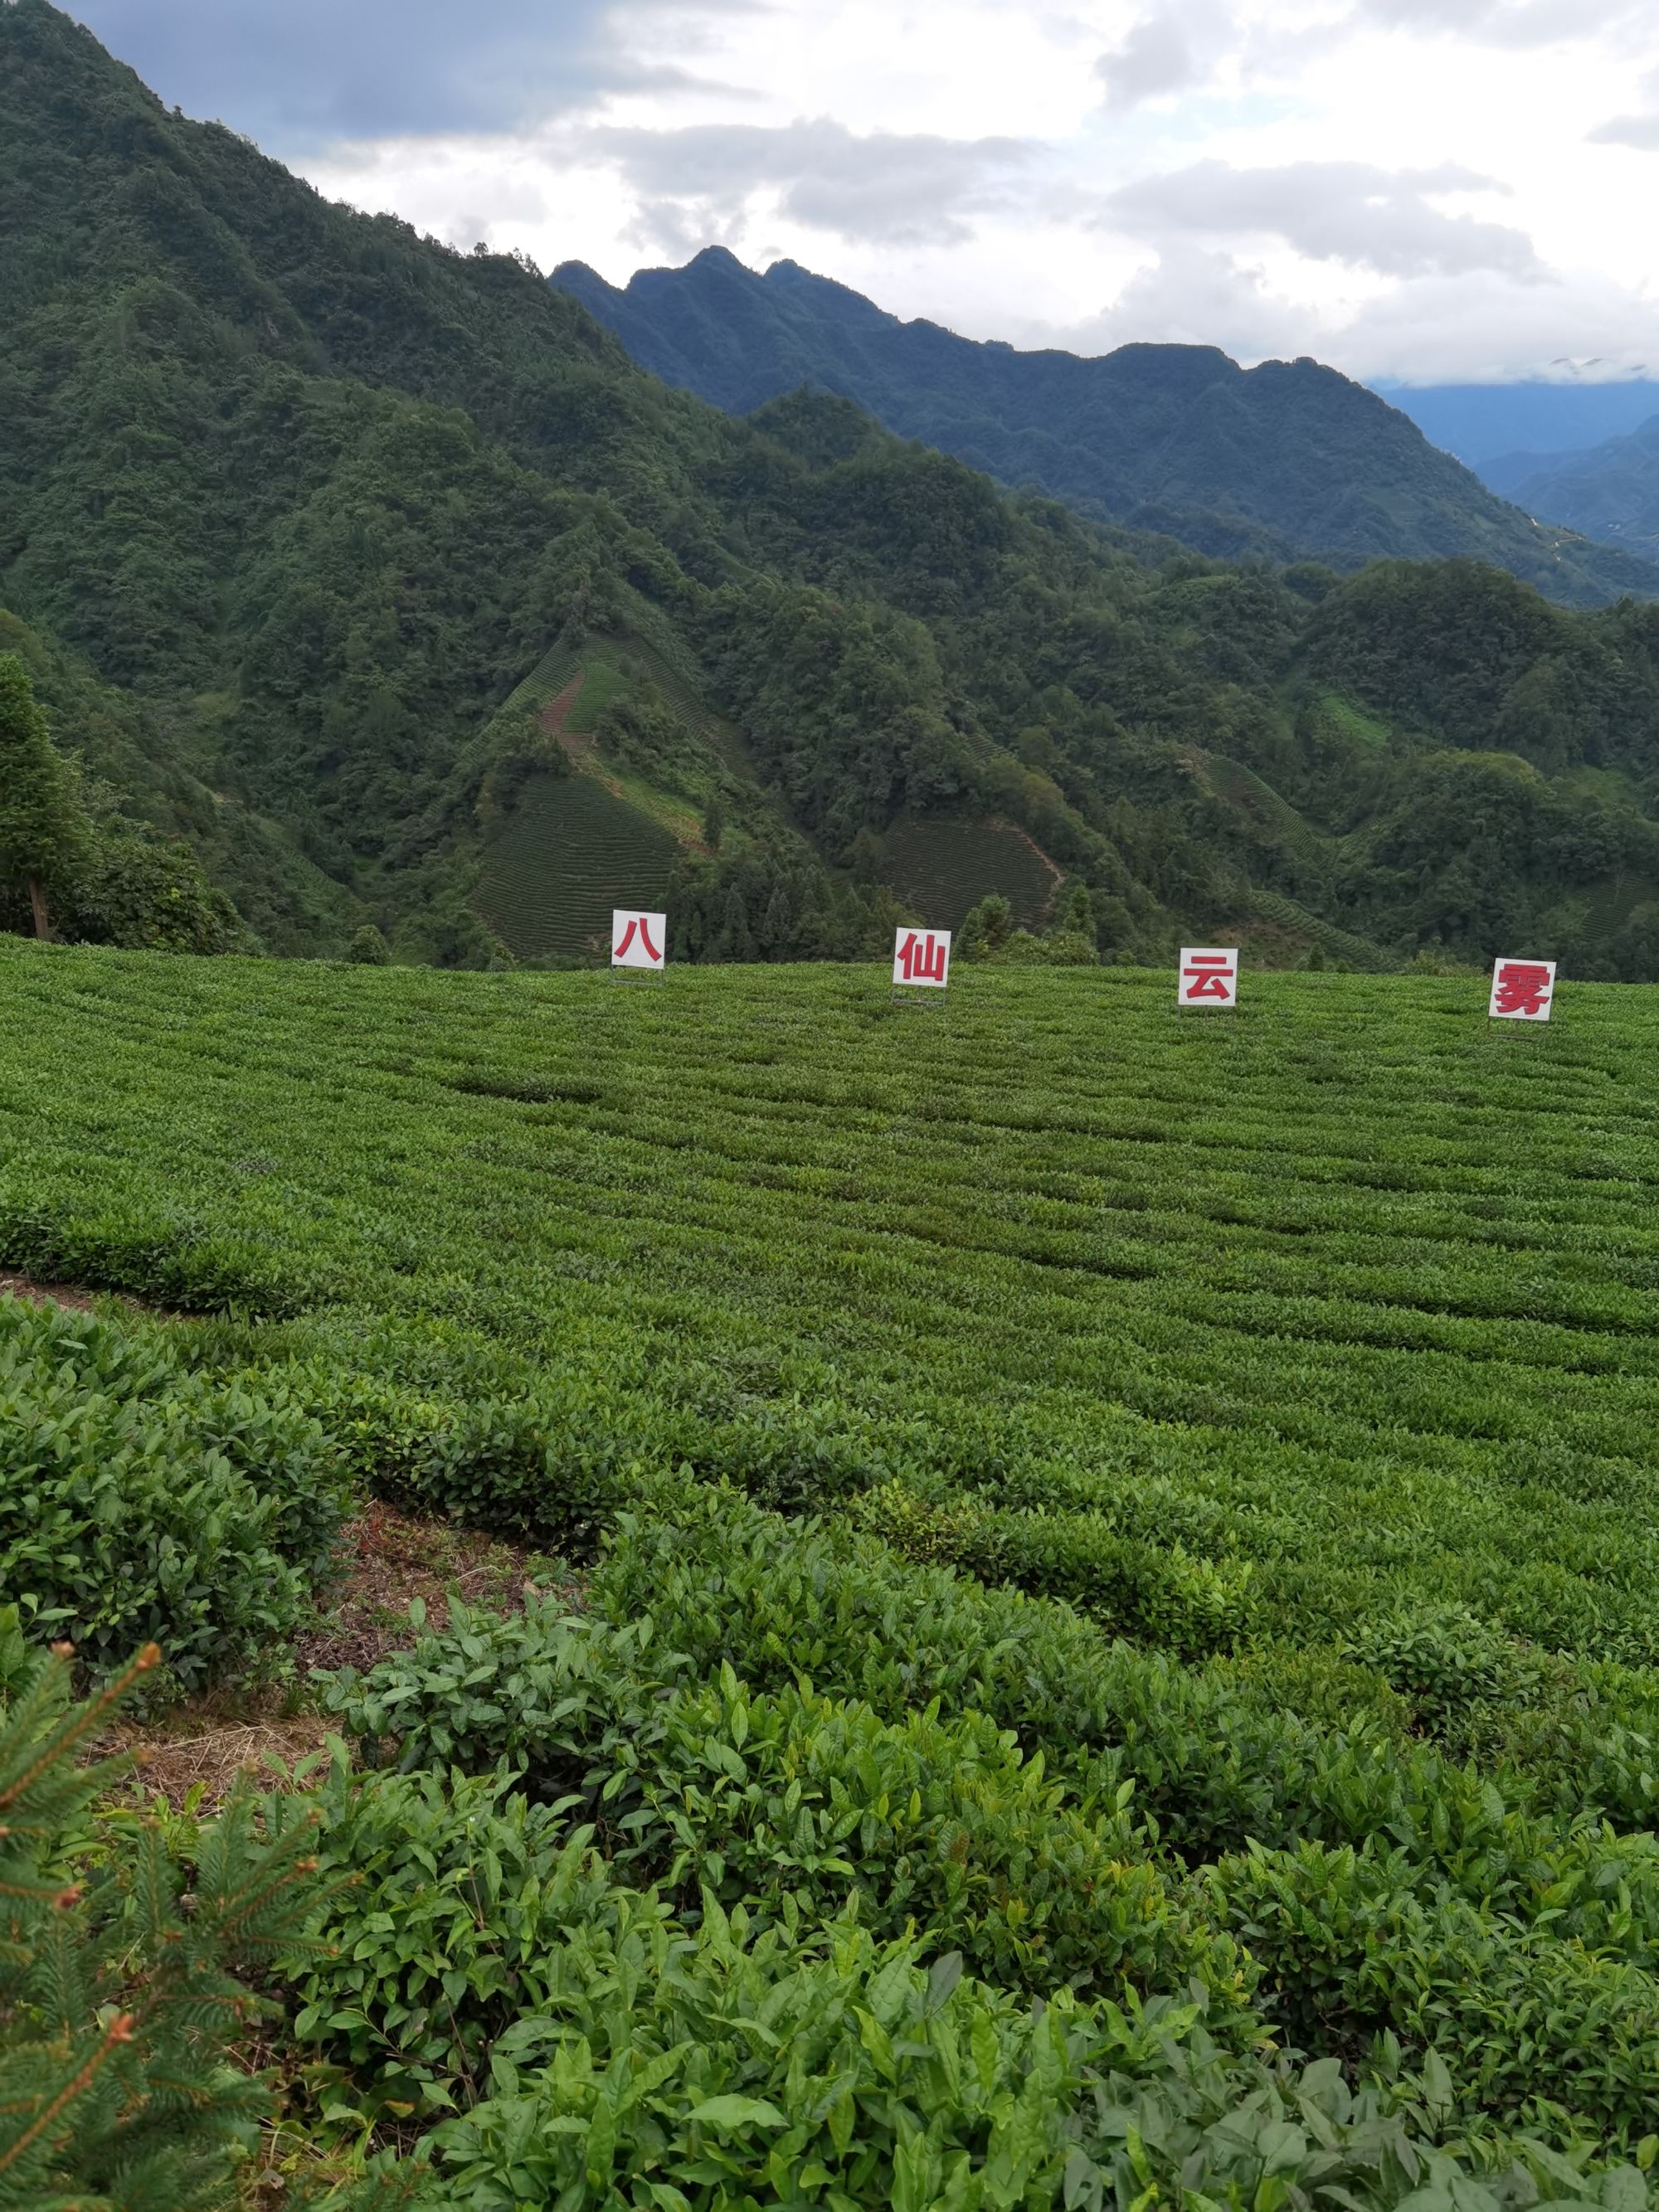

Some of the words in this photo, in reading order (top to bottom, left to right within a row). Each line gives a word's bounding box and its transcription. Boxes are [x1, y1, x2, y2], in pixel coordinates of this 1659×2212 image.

[614, 917, 662, 962] 八
[897, 932, 946, 982] 仙
[1183, 955, 1233, 1000] 云
[1495, 963, 1550, 1015] 雾
